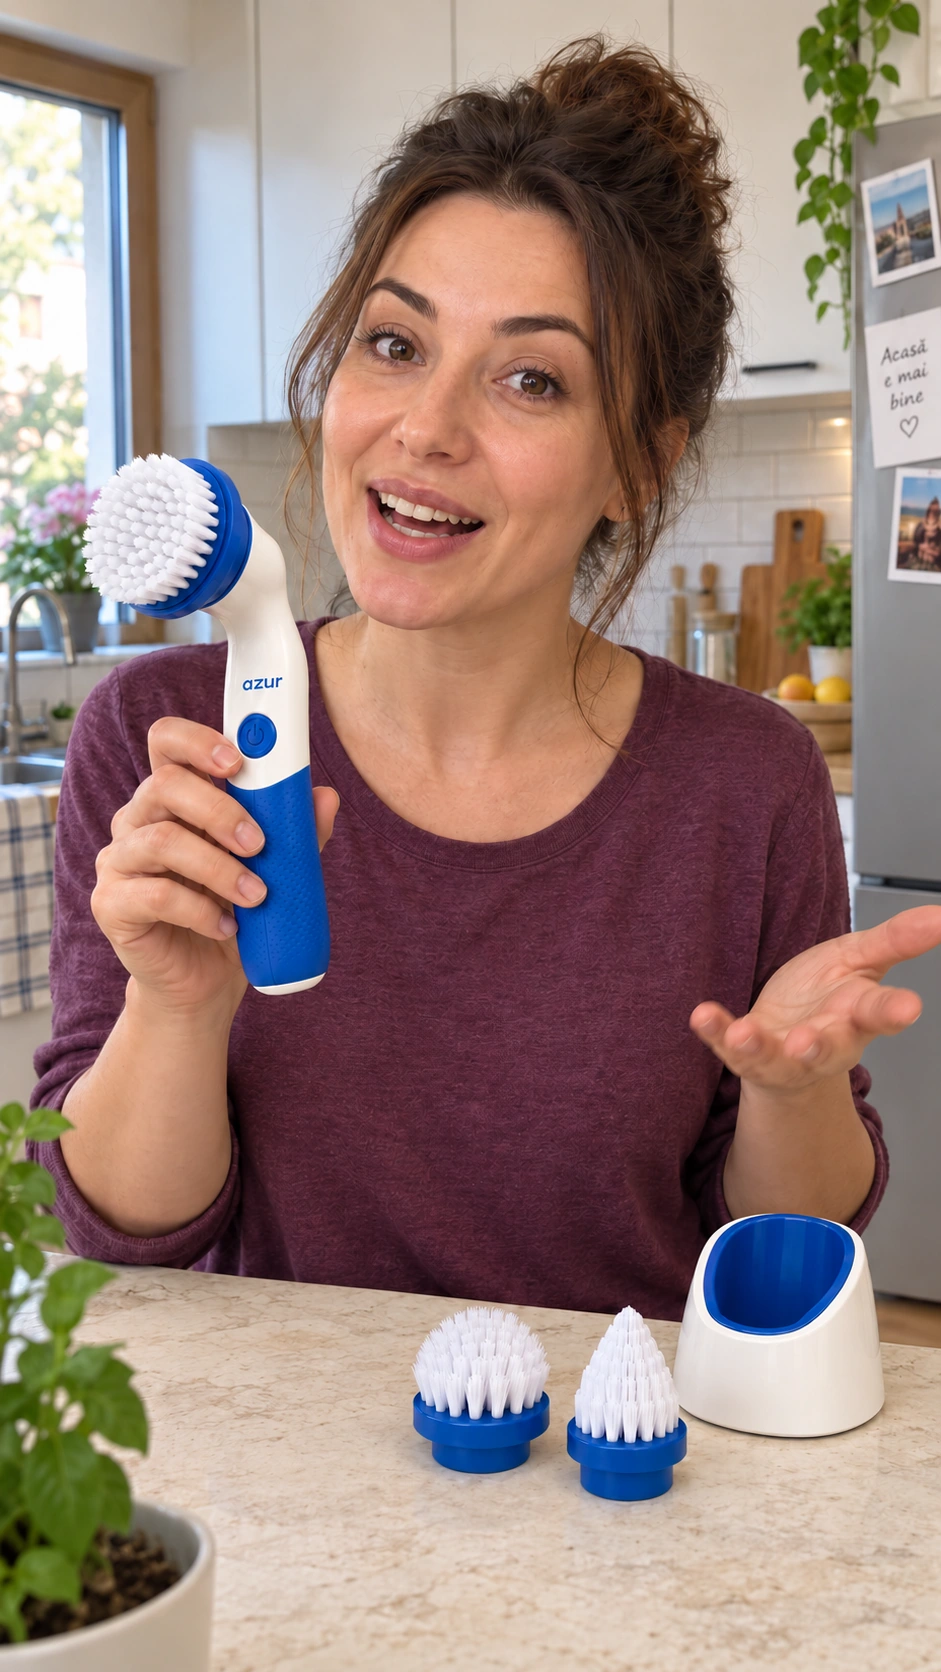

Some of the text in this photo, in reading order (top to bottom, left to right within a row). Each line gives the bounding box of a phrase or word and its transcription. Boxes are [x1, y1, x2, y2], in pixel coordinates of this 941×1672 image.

[880, 338, 928, 366] Acasă
[884, 362, 928, 388] e mai
[890, 391, 924, 410] bine
[242, 676, 283, 691] azur
